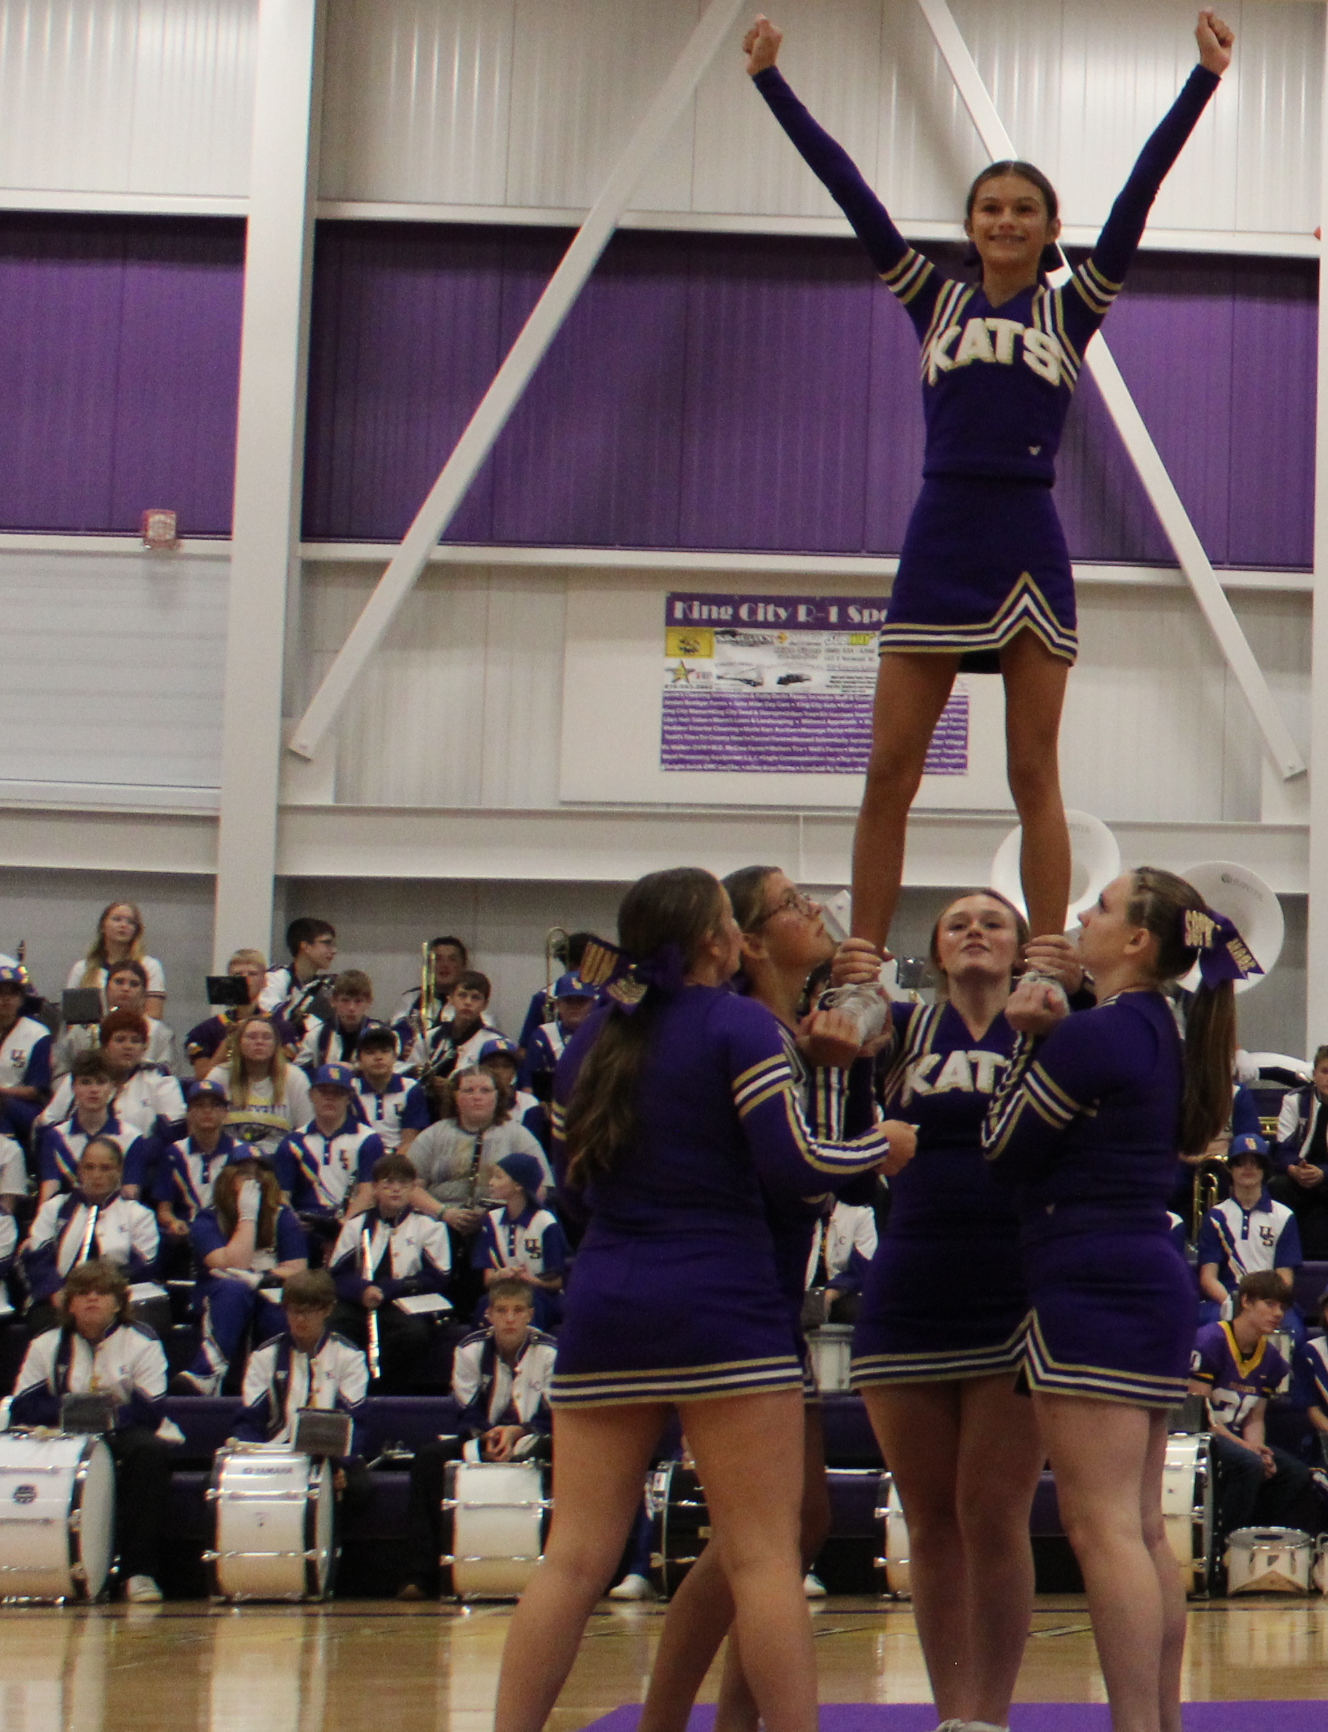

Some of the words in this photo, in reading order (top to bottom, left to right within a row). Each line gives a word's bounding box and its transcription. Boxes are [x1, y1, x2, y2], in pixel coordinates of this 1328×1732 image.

[928, 317, 1061, 387] KATS
[673, 601, 734, 622] King
[739, 603, 792, 624] City
[798, 605, 838, 624] R-1
[901, 1050, 1012, 1108] KAT
